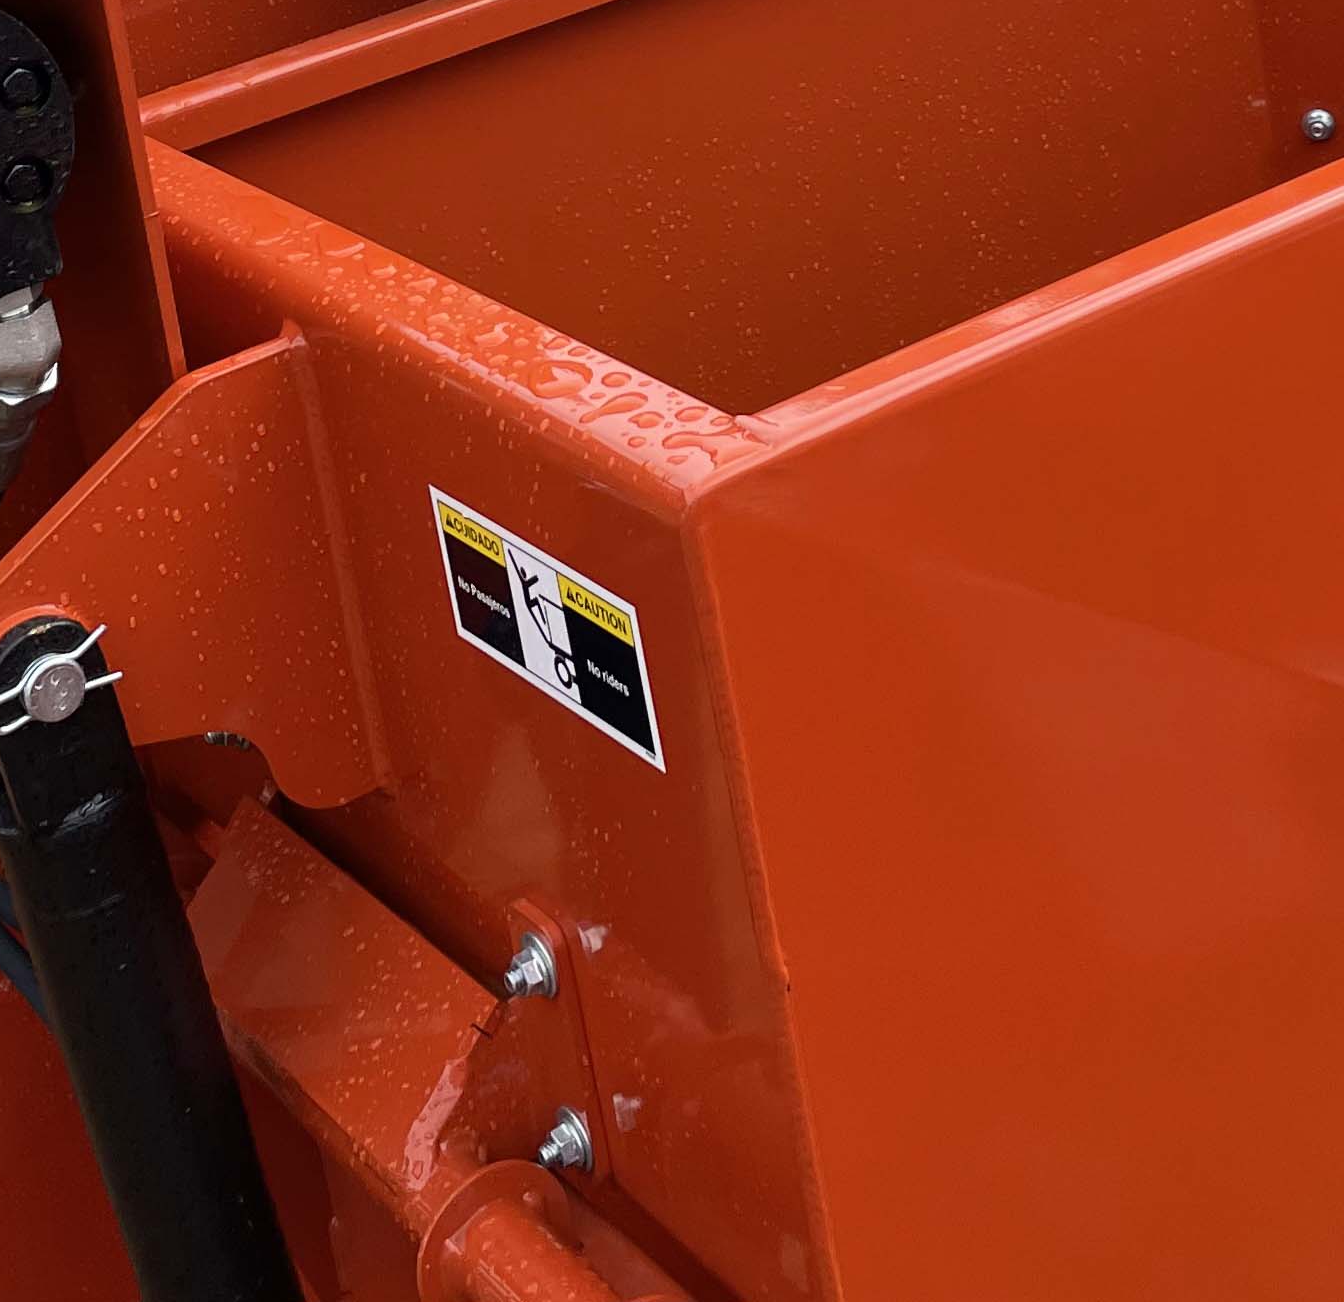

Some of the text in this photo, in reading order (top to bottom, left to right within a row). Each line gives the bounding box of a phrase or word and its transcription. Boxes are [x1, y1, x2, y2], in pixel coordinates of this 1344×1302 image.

[453, 518, 500, 556] CUIDADO
[457, 575, 470, 593] No
[575, 591, 627, 635] CAUTION
[586, 659, 629, 697] No riders
